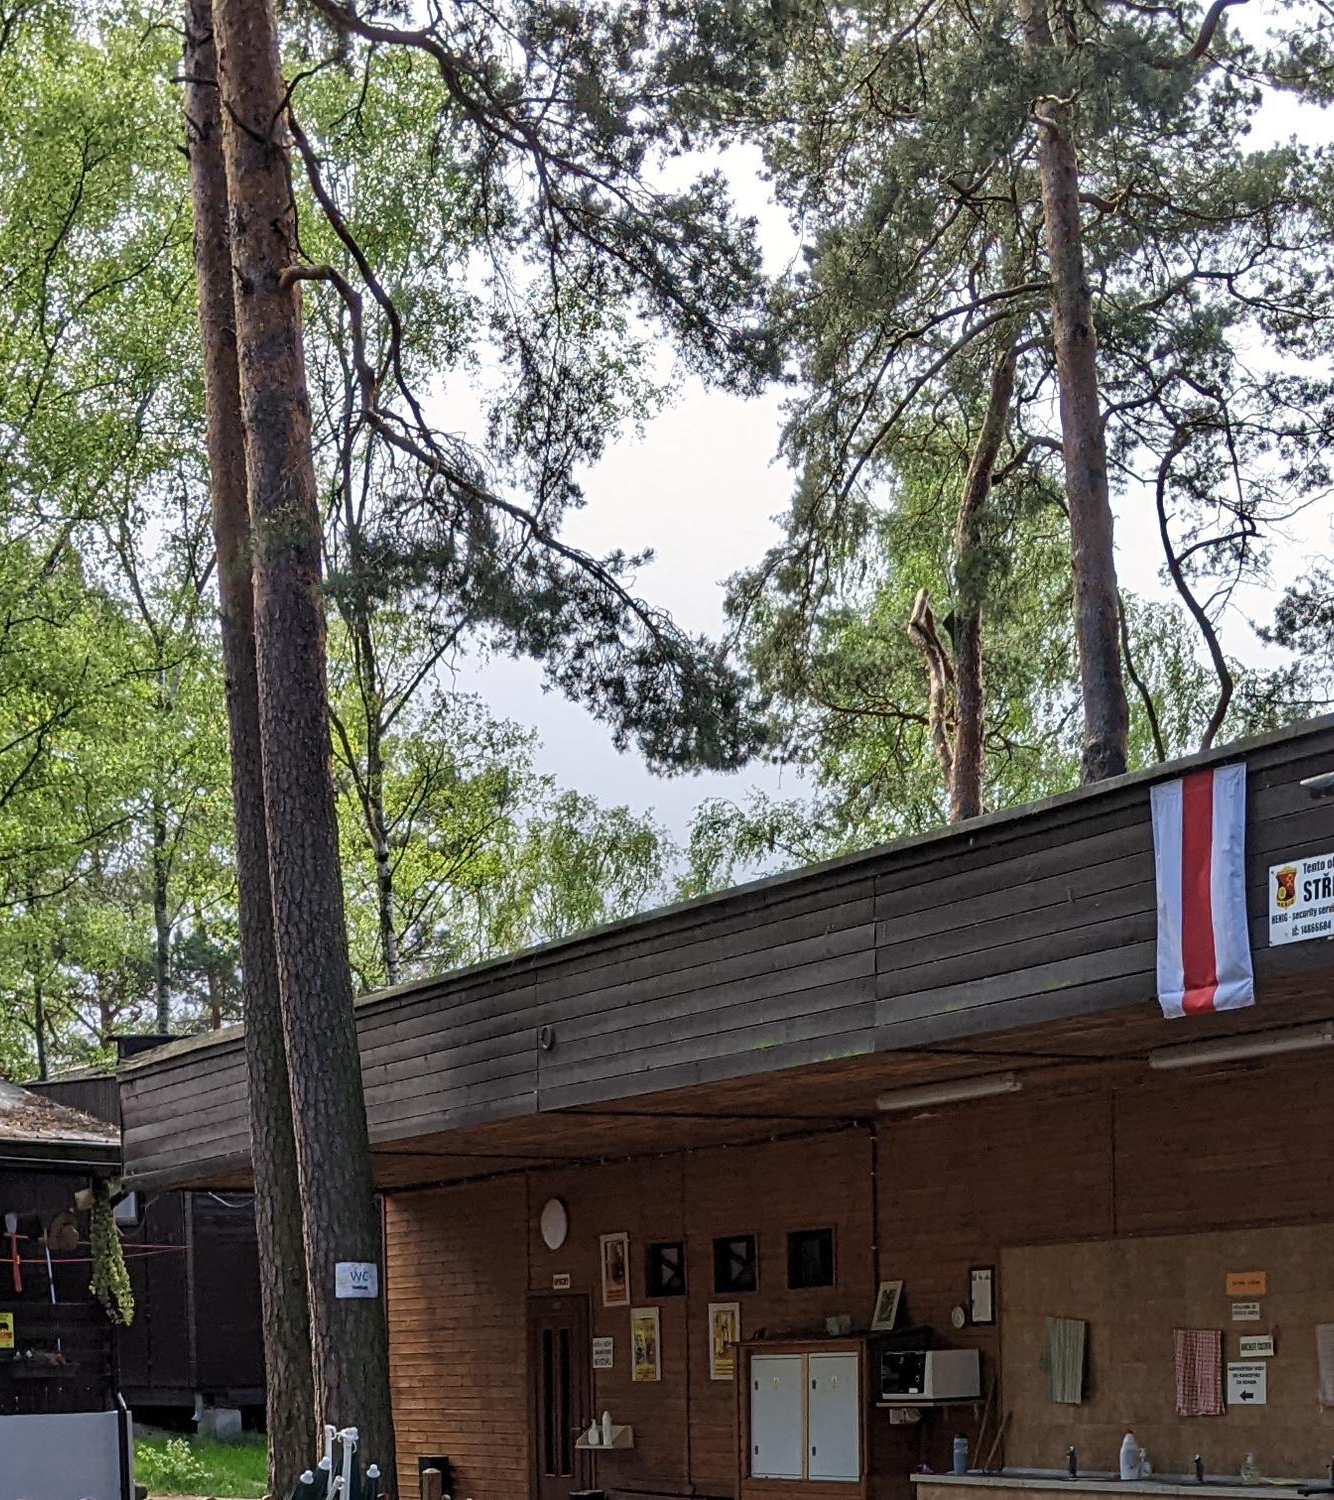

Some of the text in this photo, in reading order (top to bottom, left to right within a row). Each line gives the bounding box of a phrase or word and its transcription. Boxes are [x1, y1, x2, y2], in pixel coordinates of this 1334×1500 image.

[1303, 861, 1326, 874] Tento
[1292, 907, 1317, 921] security
[350, 1271, 369, 1281] WC
